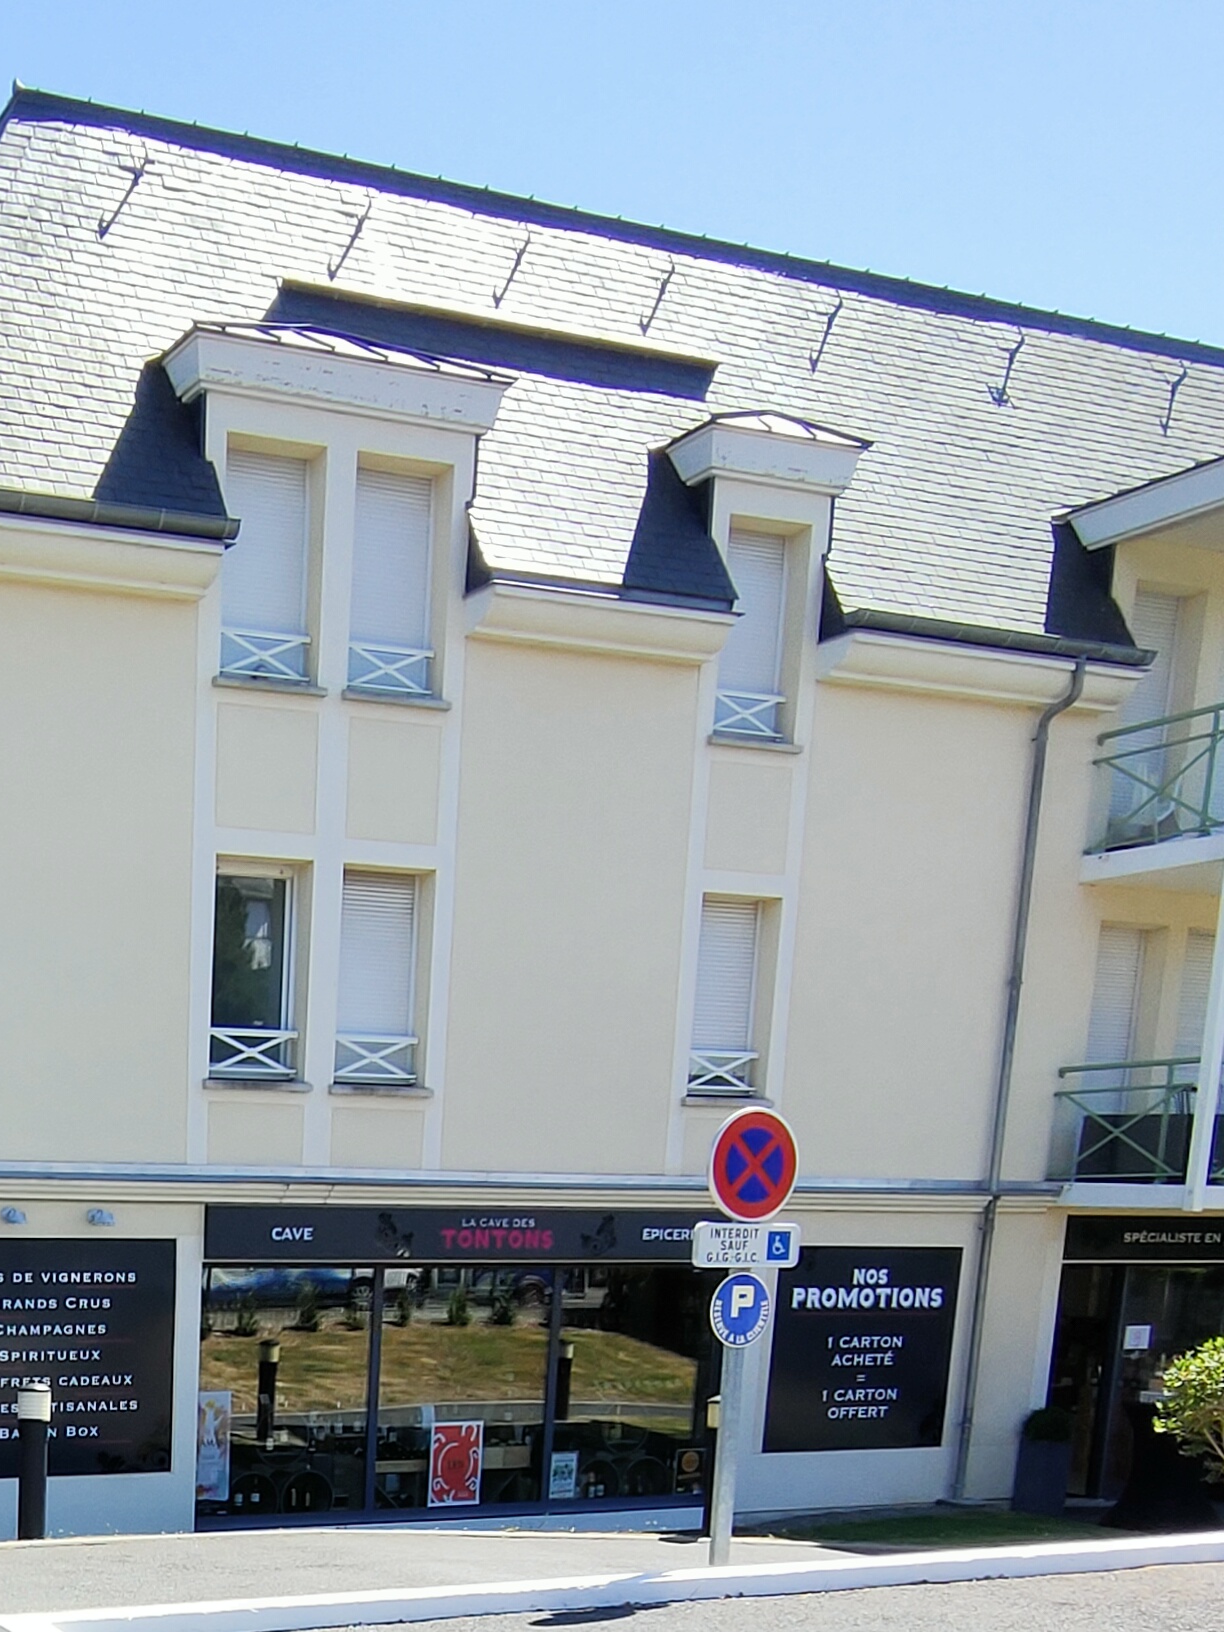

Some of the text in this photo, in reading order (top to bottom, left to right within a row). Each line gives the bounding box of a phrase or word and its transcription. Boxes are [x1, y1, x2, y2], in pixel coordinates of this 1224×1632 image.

[461, 1218, 536, 1228] LA CAVE DES
[271, 1227, 314, 1241] CAVE
[441, 1229, 554, 1249] TONTONS
[710, 1227, 760, 1240] INTERDIT
[1123, 1229, 1222, 1244] SPÉCIALISTE EN
[720, 1240, 749, 1251] SAUF
[12, 1272, 34, 1283] DE
[41, 1272, 137, 1284] VIGNERONS
[852, 1268, 889, 1286] NOS
[65, 1297, 112, 1309] CRUS
[730, 1285, 755, 1318] P
[791, 1287, 943, 1310] PROMOTIONS
[827, 1336, 904, 1349] 1 CARTON
[830, 1350, 895, 1367] ACHETÉ
[58, 1374, 133, 1387] CADEAUX
[856, 1374, 866, 1383] =
[822, 1389, 899, 1403] 1 CARTON
[51, 1400, 139, 1413] TISANALES
[827, 1406, 889, 1420] OFFERT
[66, 1426, 100, 1438] BOX
